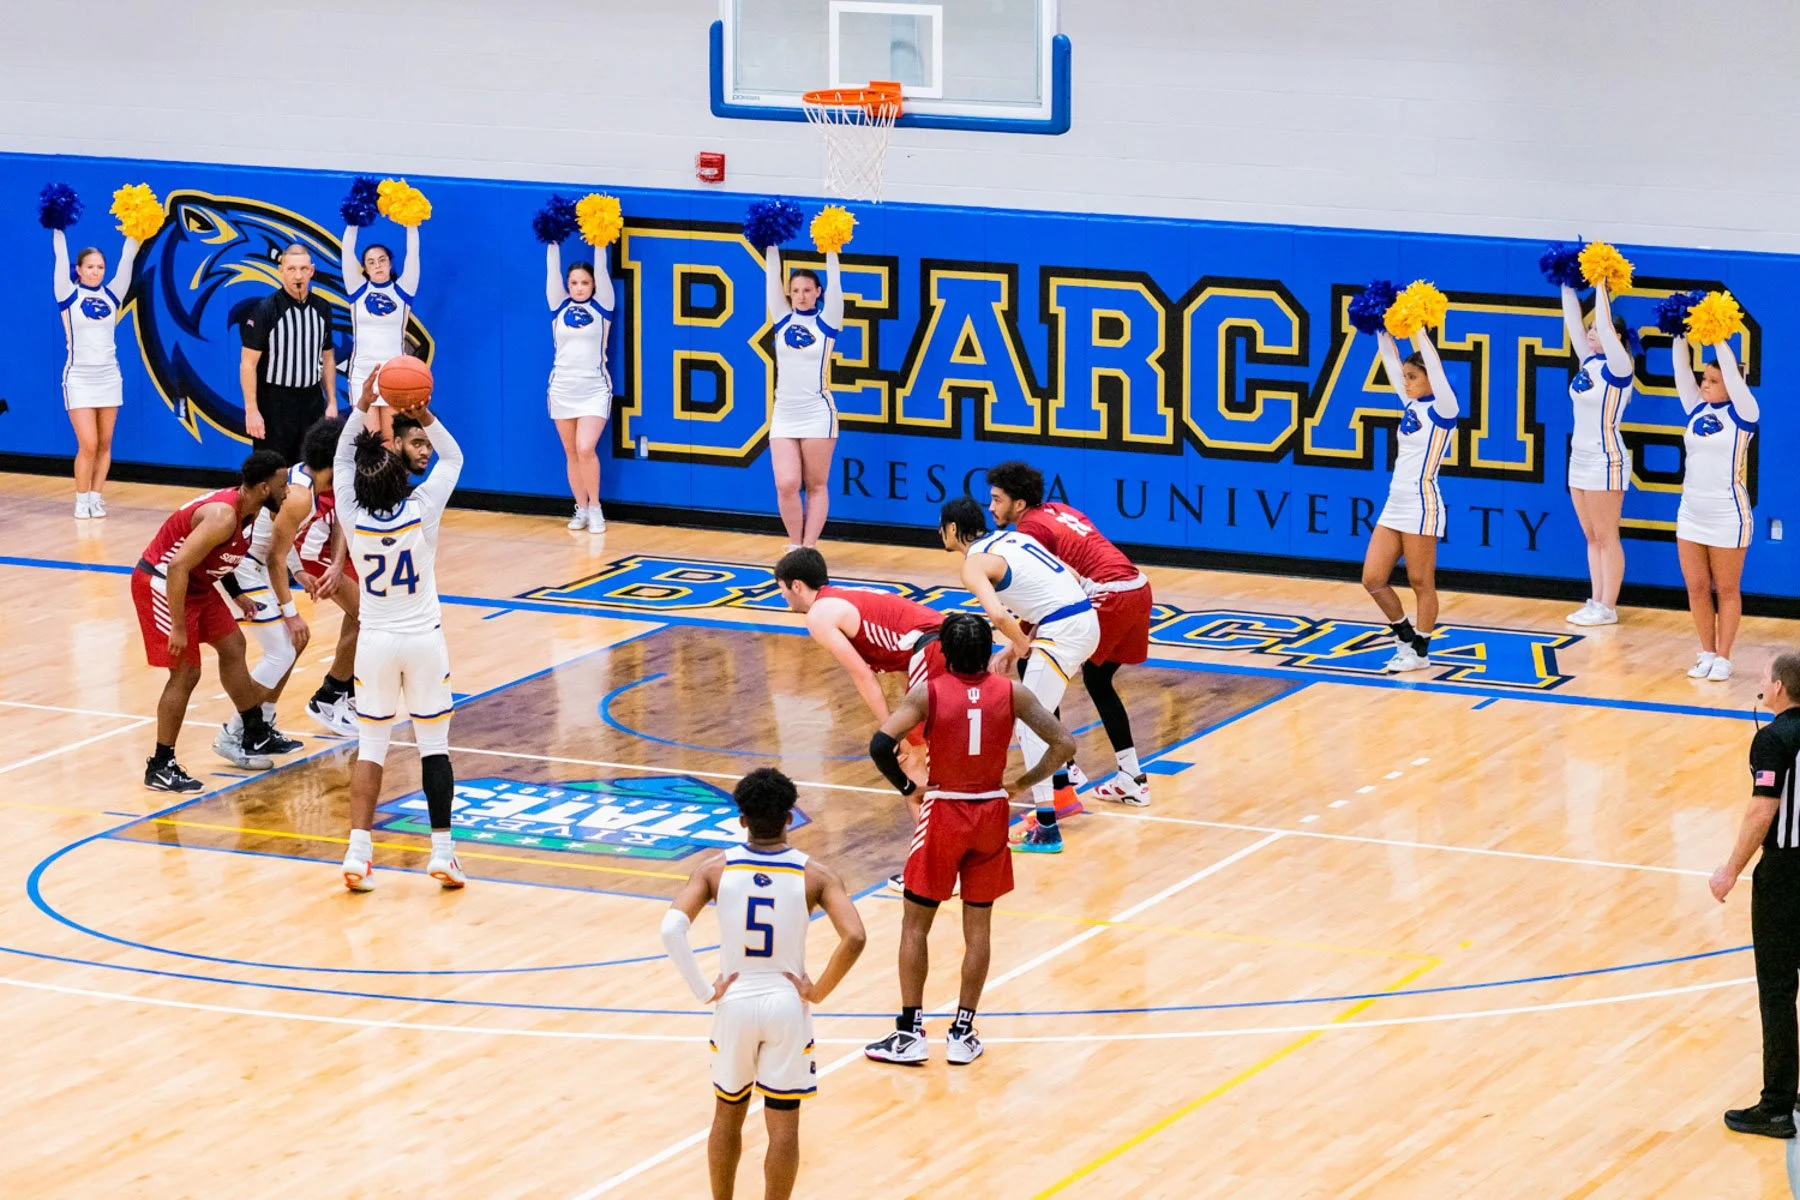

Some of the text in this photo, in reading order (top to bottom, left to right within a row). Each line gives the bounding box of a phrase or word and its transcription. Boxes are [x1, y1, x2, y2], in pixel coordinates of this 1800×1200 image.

[613, 216, 1762, 542] BEARCATS
[803, 455, 1072, 508] RESCA
[1116, 477, 1550, 553] UNIVERITY
[364, 548, 420, 597] 24
[1021, 543, 1065, 574] 0
[965, 708, 983, 756] 1
[492, 782, 732, 815] ONFERENCE
[744, 896, 775, 958] 5
